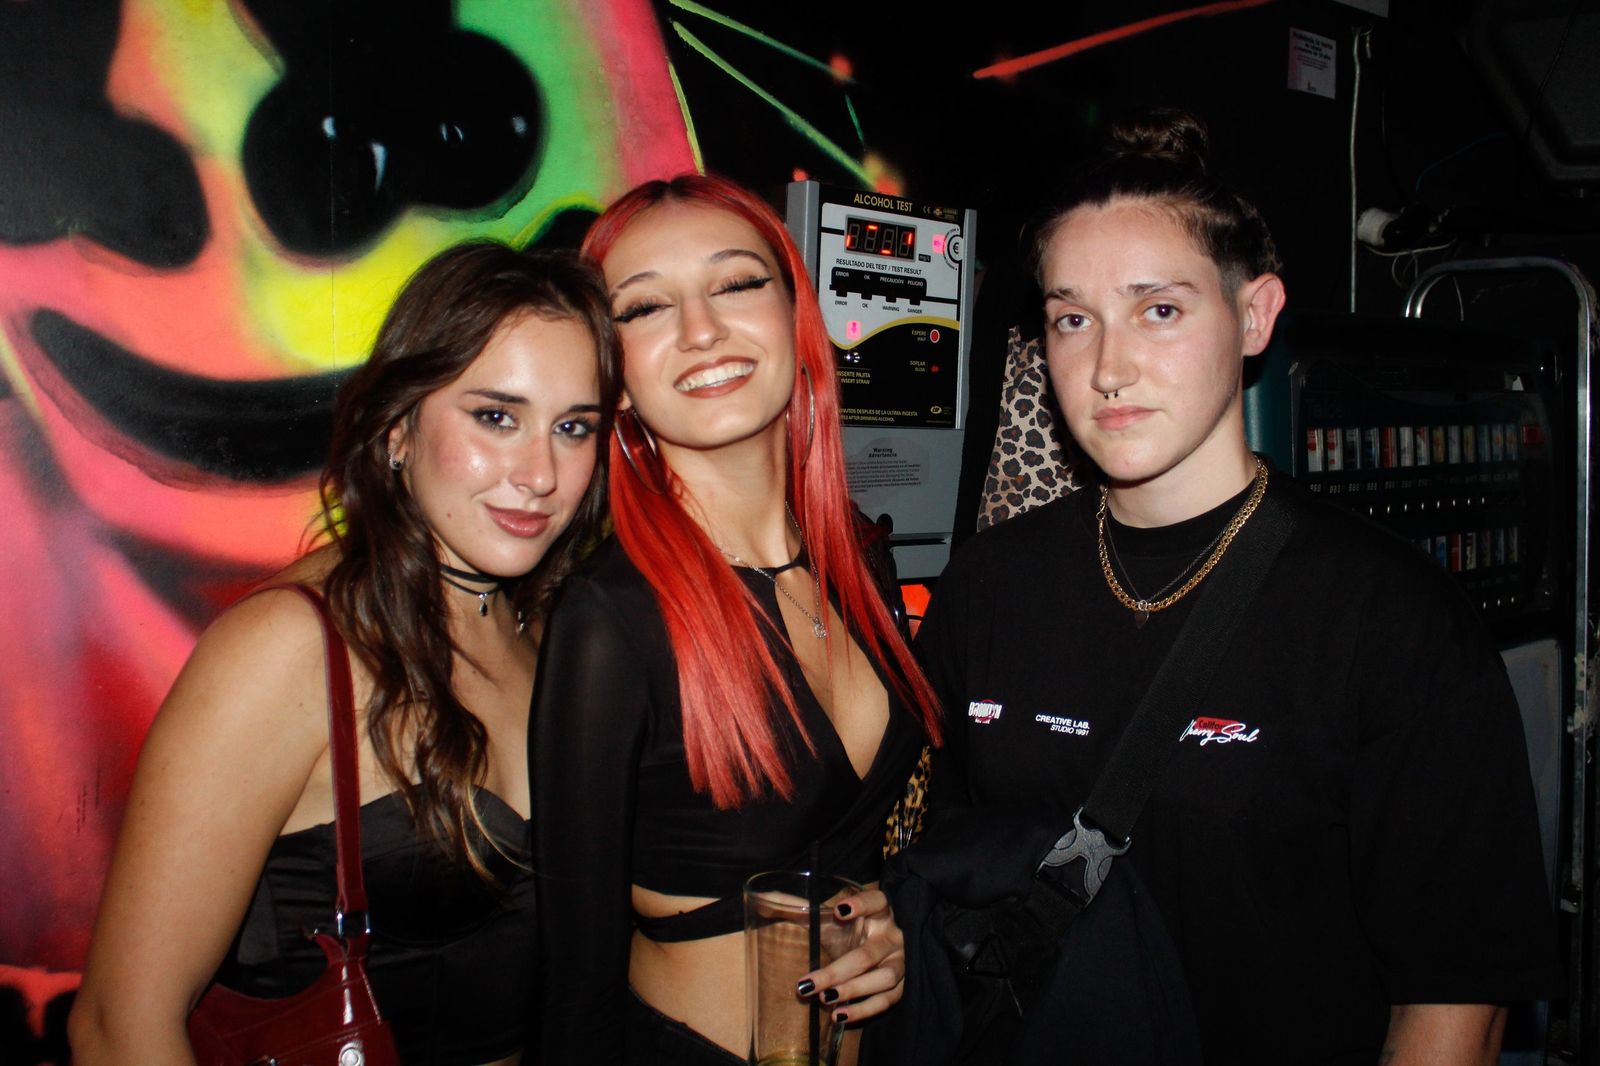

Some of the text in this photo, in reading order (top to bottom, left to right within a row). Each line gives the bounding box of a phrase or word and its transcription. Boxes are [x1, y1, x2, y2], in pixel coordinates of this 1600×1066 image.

[853, 193, 913, 213] ALCOHOL TEST
[836, 258, 865, 268] RESULTADO
[903, 267, 922, 276] RESULT
[835, 270, 849, 278] ERROR
[907, 279, 924, 287] PELIGRO
[1035, 714, 1090, 729] CREATIVE LAB.
[1050, 724, 1075, 735] STUDIO
